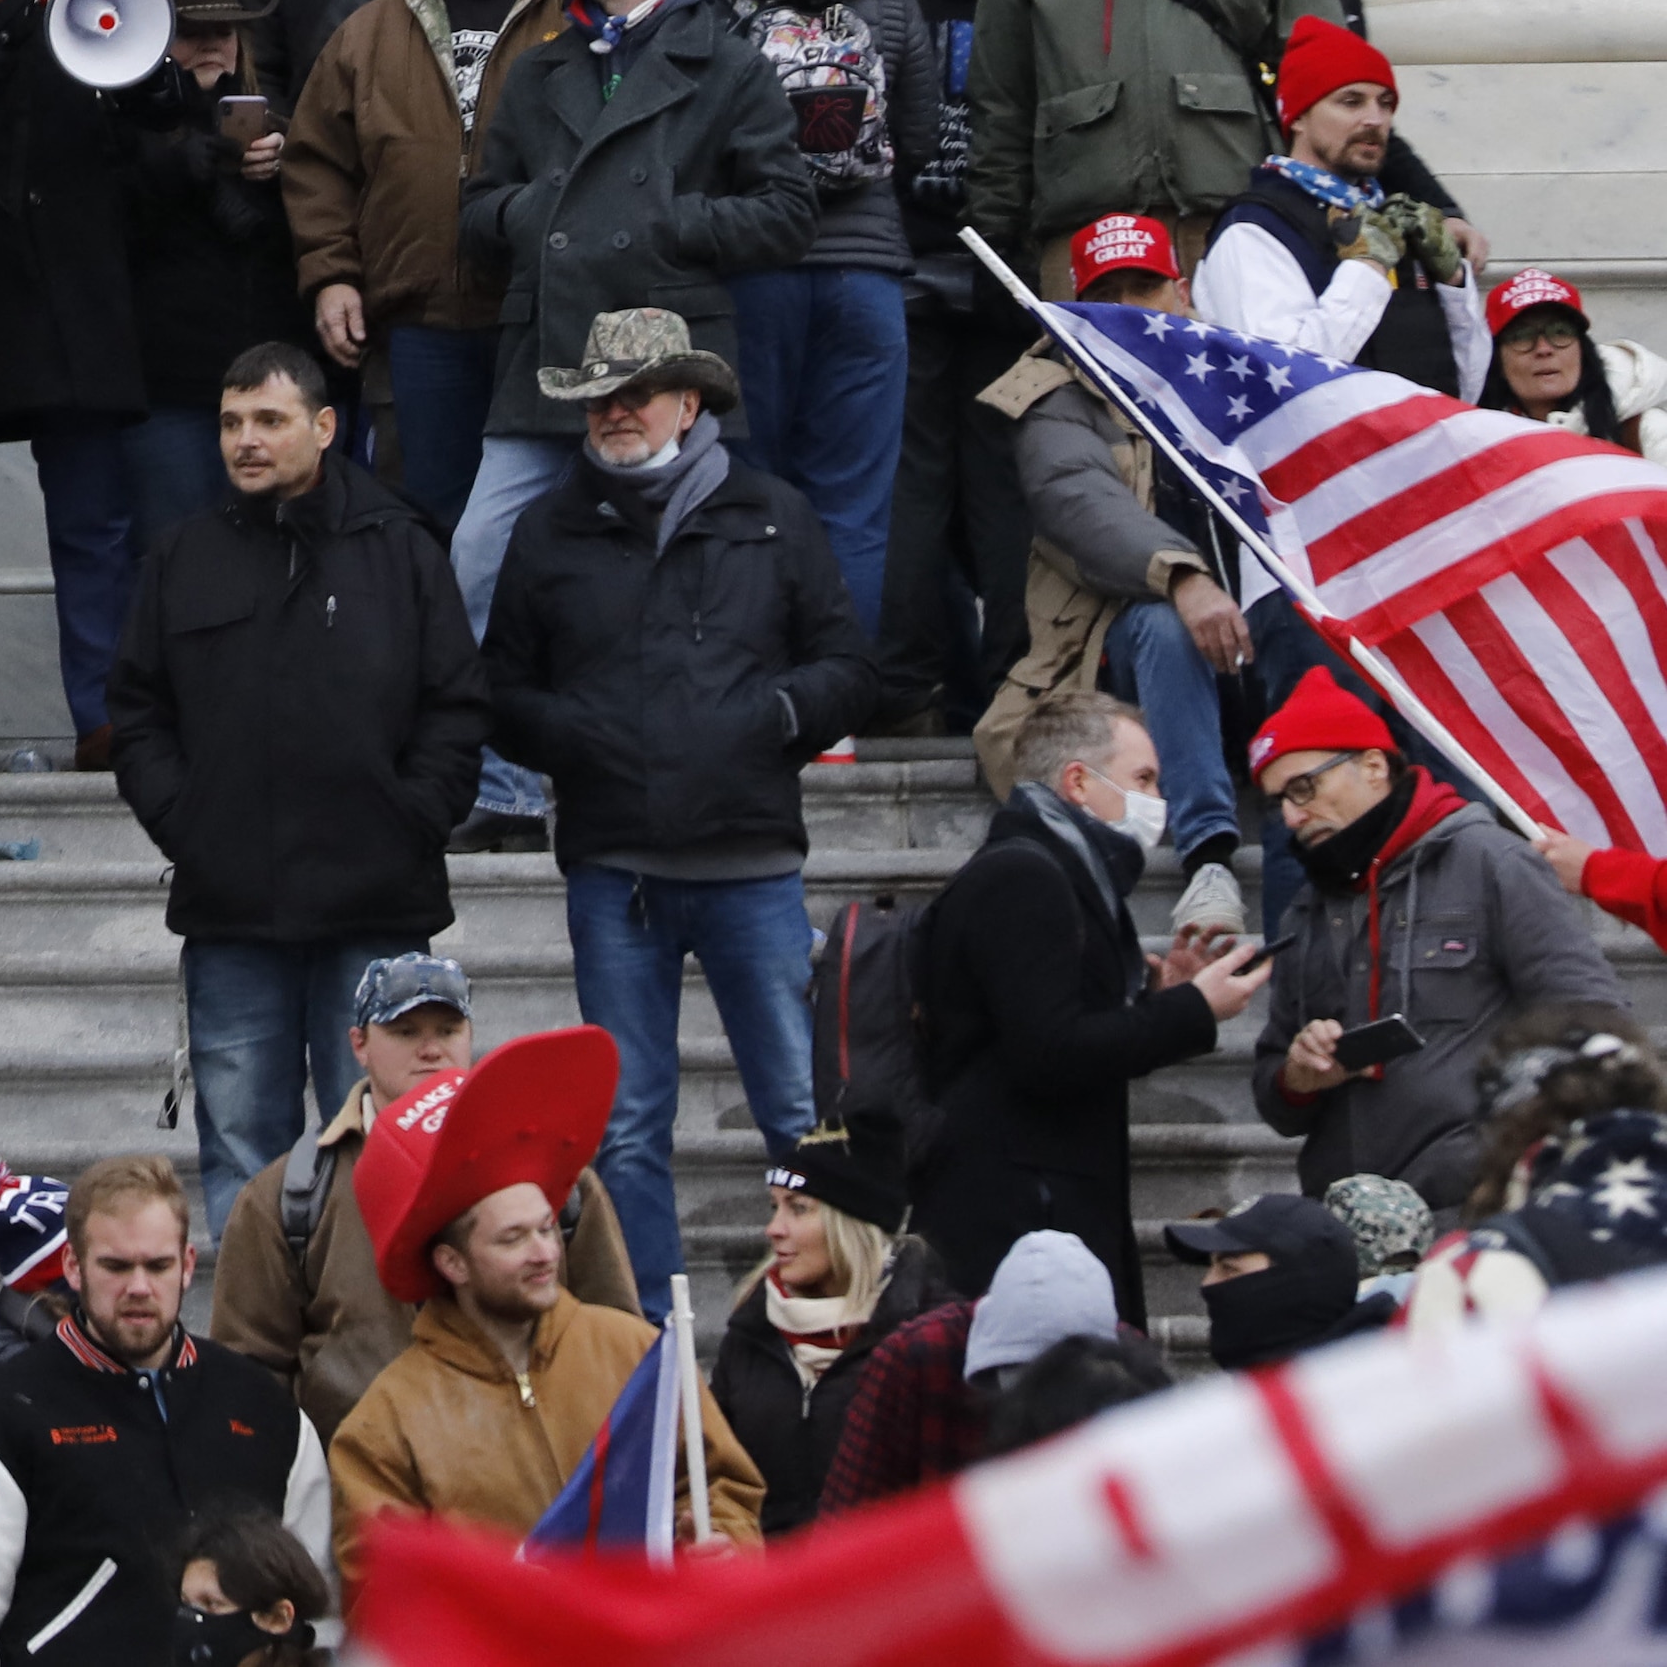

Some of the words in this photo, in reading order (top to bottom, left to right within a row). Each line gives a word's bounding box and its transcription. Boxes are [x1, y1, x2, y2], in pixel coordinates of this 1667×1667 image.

[1095, 215, 1137, 235] KEEP
[1084, 229, 1156, 256] AMERICA
[1094, 243, 1147, 265] GREAT
[1512, 268, 1553, 285] KEEP
[1500, 279, 1572, 305] AMERICA
[395, 1081, 457, 1132] MAKE
